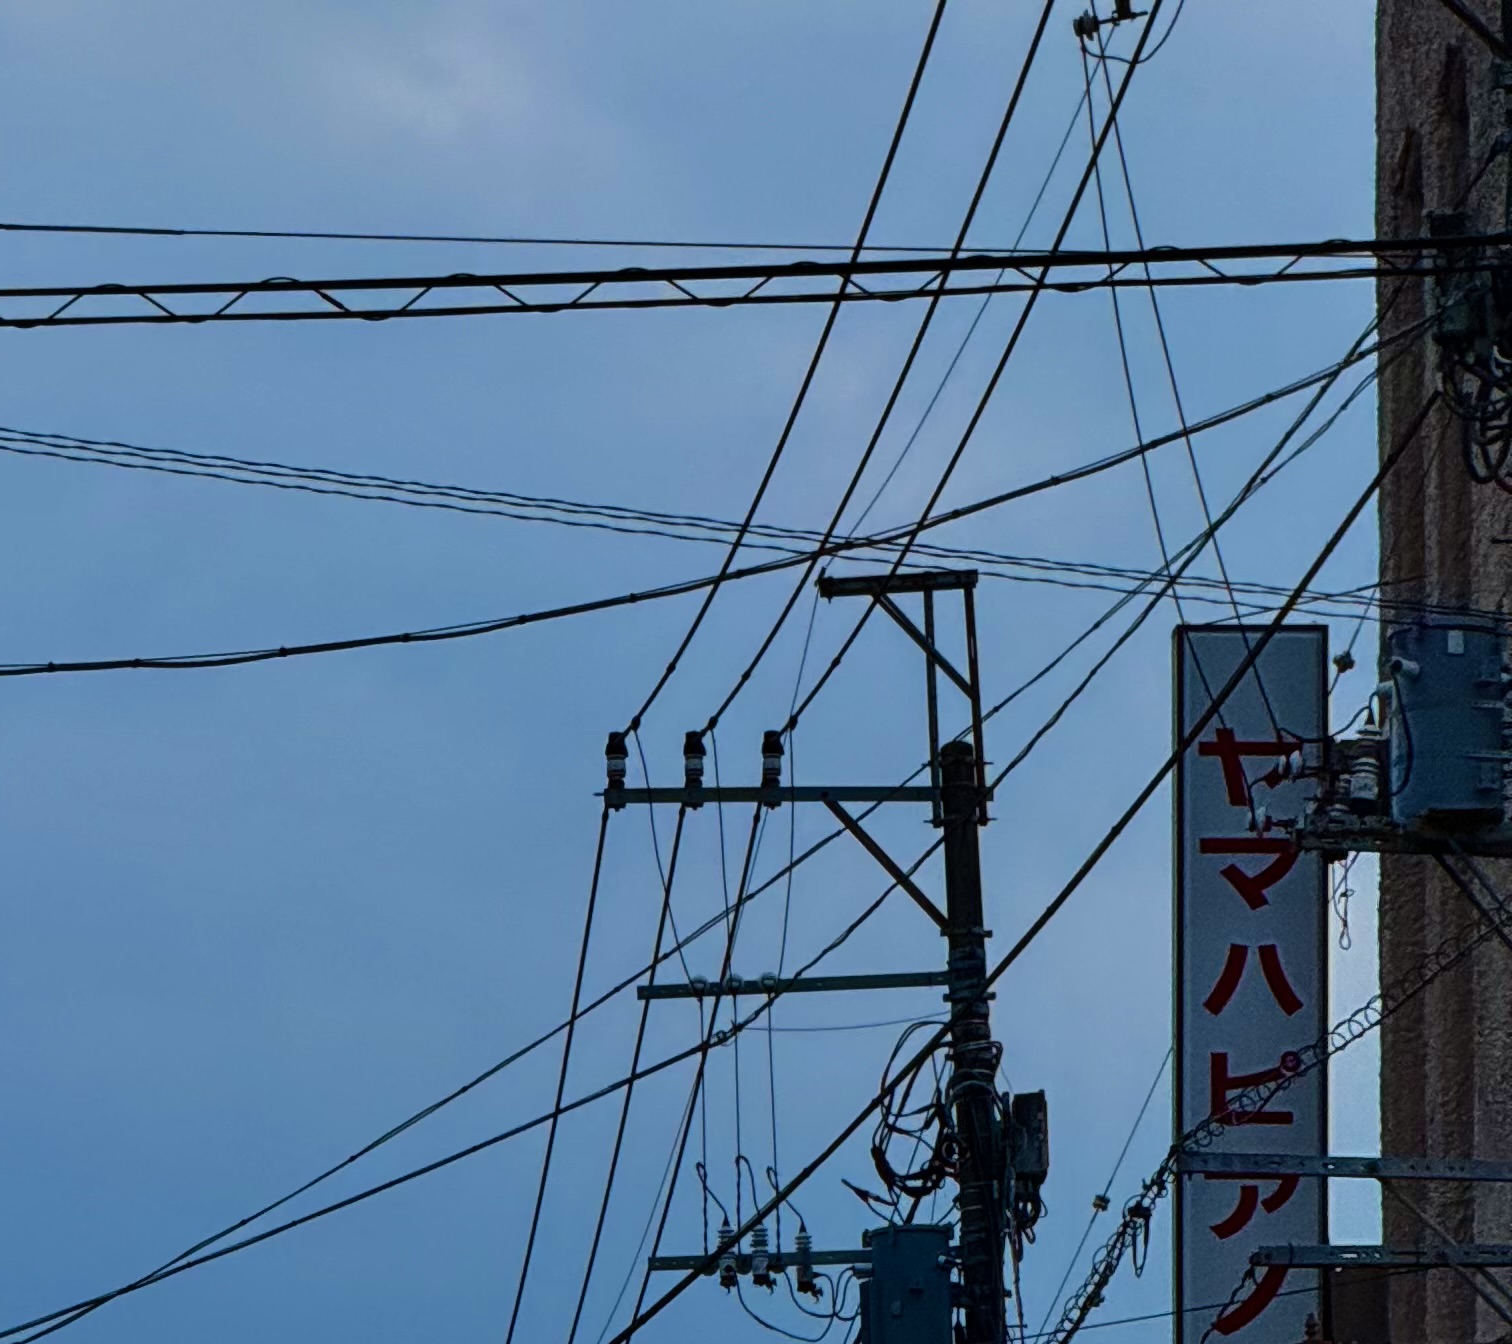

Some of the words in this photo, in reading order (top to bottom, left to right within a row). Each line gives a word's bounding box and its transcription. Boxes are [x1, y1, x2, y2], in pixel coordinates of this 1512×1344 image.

[1198, 727, 1303, 1337] ヤマハピアノ
